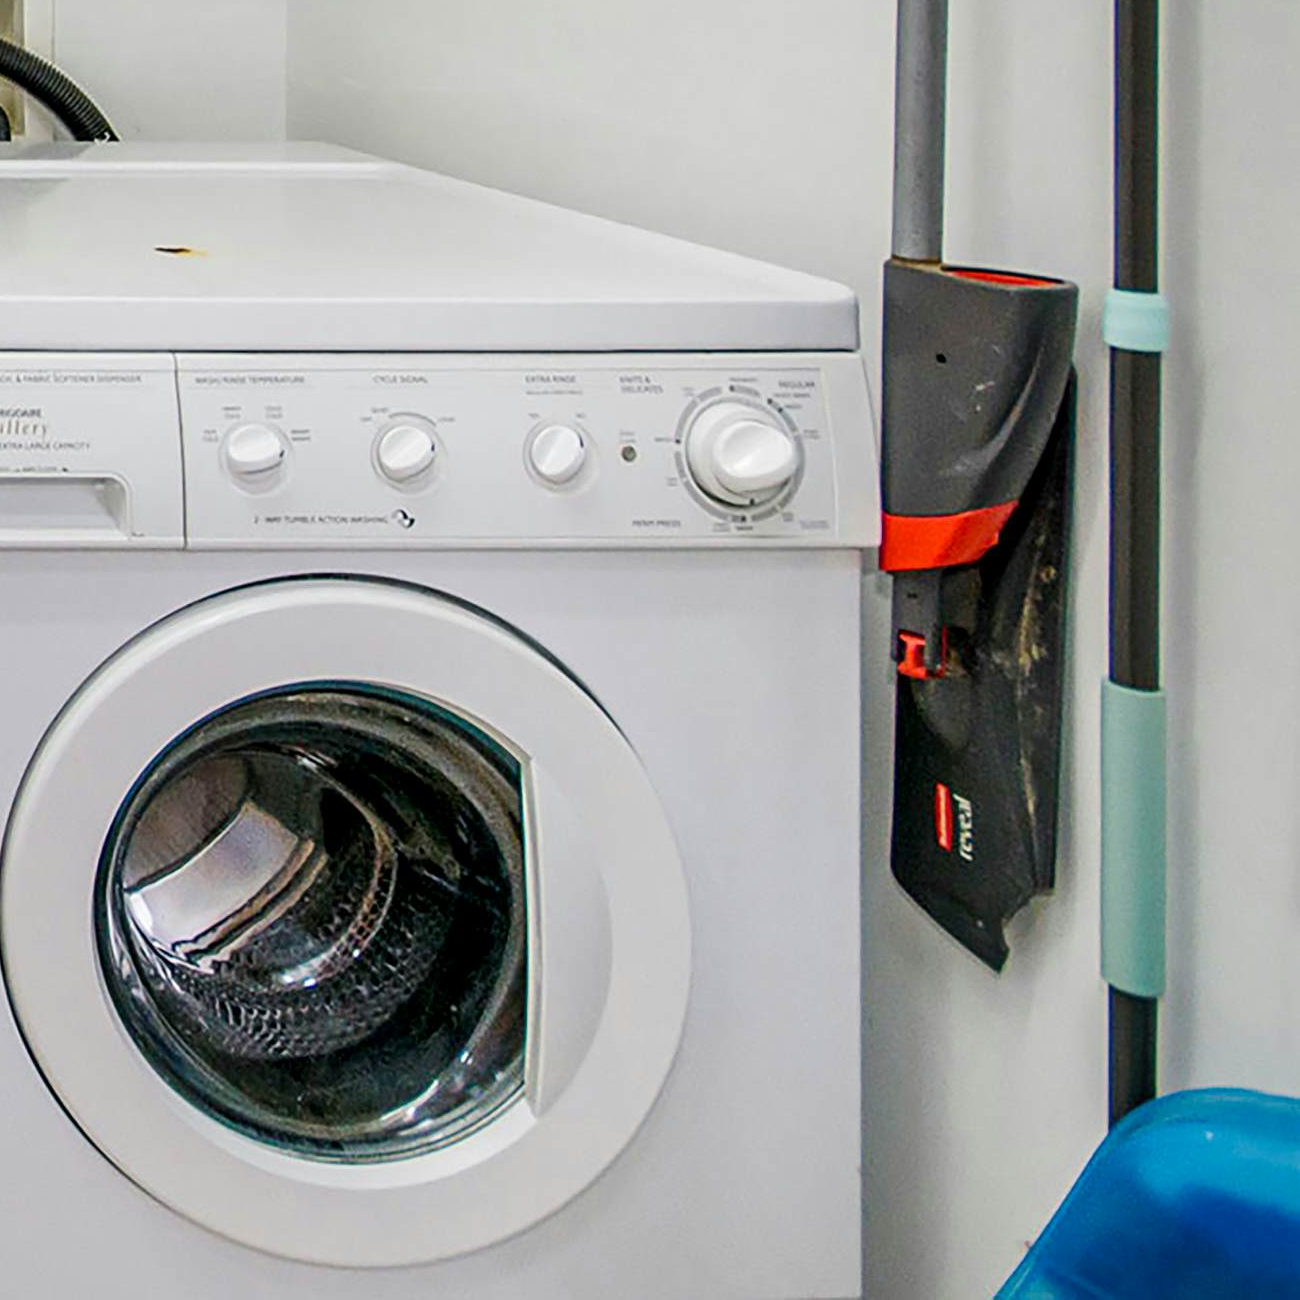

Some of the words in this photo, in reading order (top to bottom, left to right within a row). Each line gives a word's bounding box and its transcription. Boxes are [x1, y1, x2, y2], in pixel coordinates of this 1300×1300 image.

[248, 375, 305, 384] TEMPERATURE
[372, 375, 397, 383] CYCLE
[399, 375, 428, 383] SIGNAL
